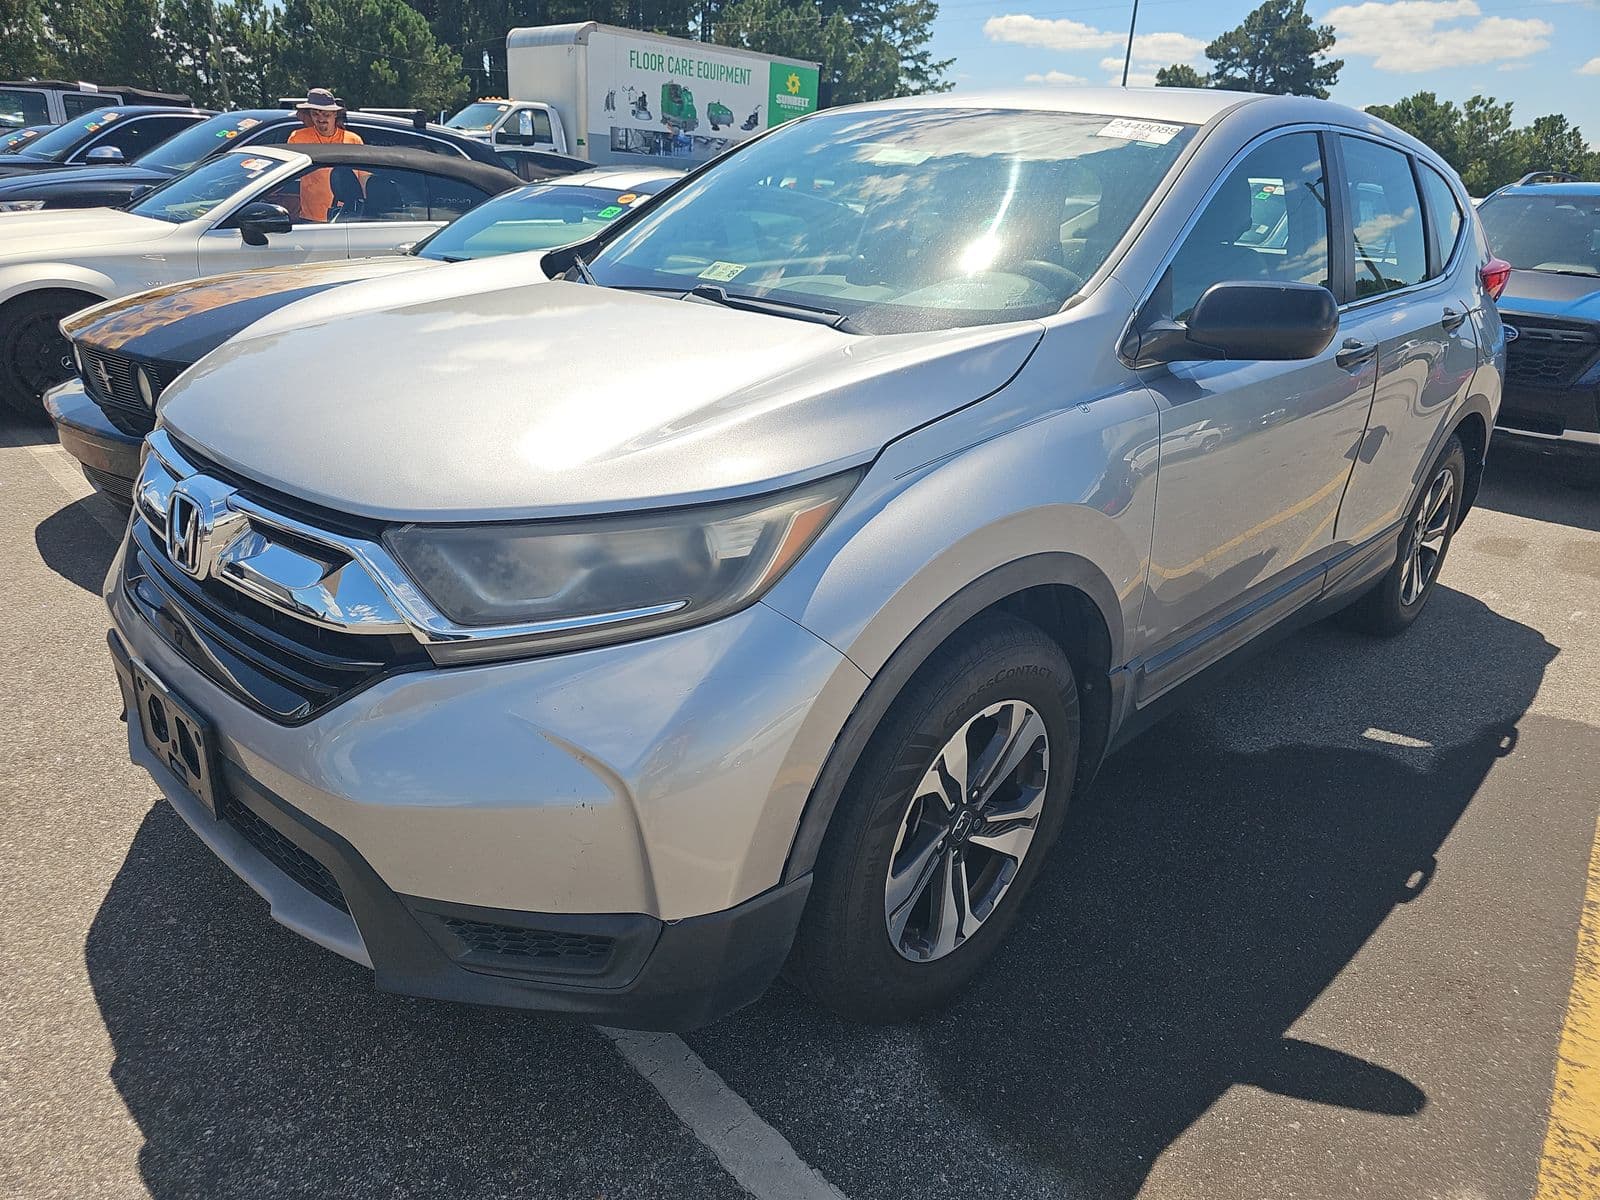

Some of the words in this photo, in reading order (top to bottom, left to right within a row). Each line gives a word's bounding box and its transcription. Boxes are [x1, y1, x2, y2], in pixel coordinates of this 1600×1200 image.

[629, 50, 665, 73] FLOOR
[667, 56, 694, 77] CARE
[697, 61, 752, 86] EQUIPMENT
[776, 94, 810, 107] SUNBELT
